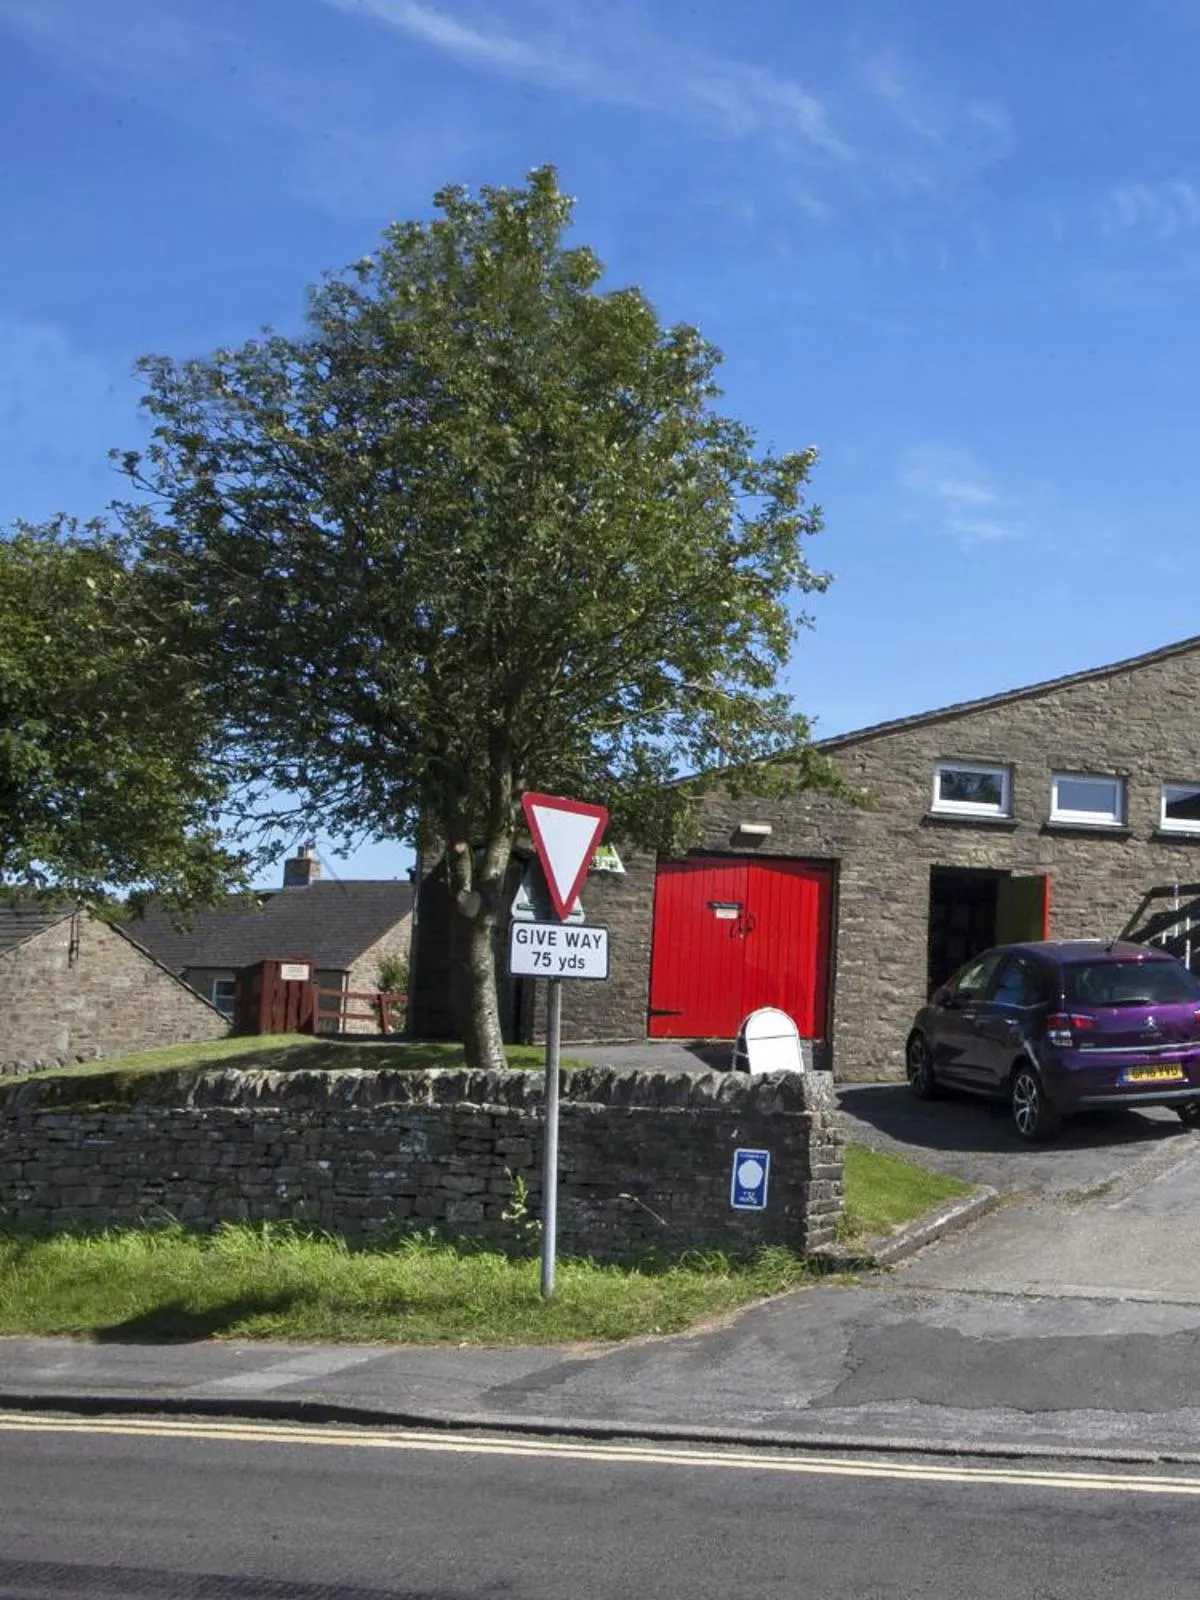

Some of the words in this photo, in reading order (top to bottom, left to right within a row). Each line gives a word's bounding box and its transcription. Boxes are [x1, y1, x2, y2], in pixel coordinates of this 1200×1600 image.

[516, 929, 557, 946] GIVE
[565, 932, 602, 949] WAY
[531, 951, 552, 968] 75
[558, 954, 586, 972] yds
